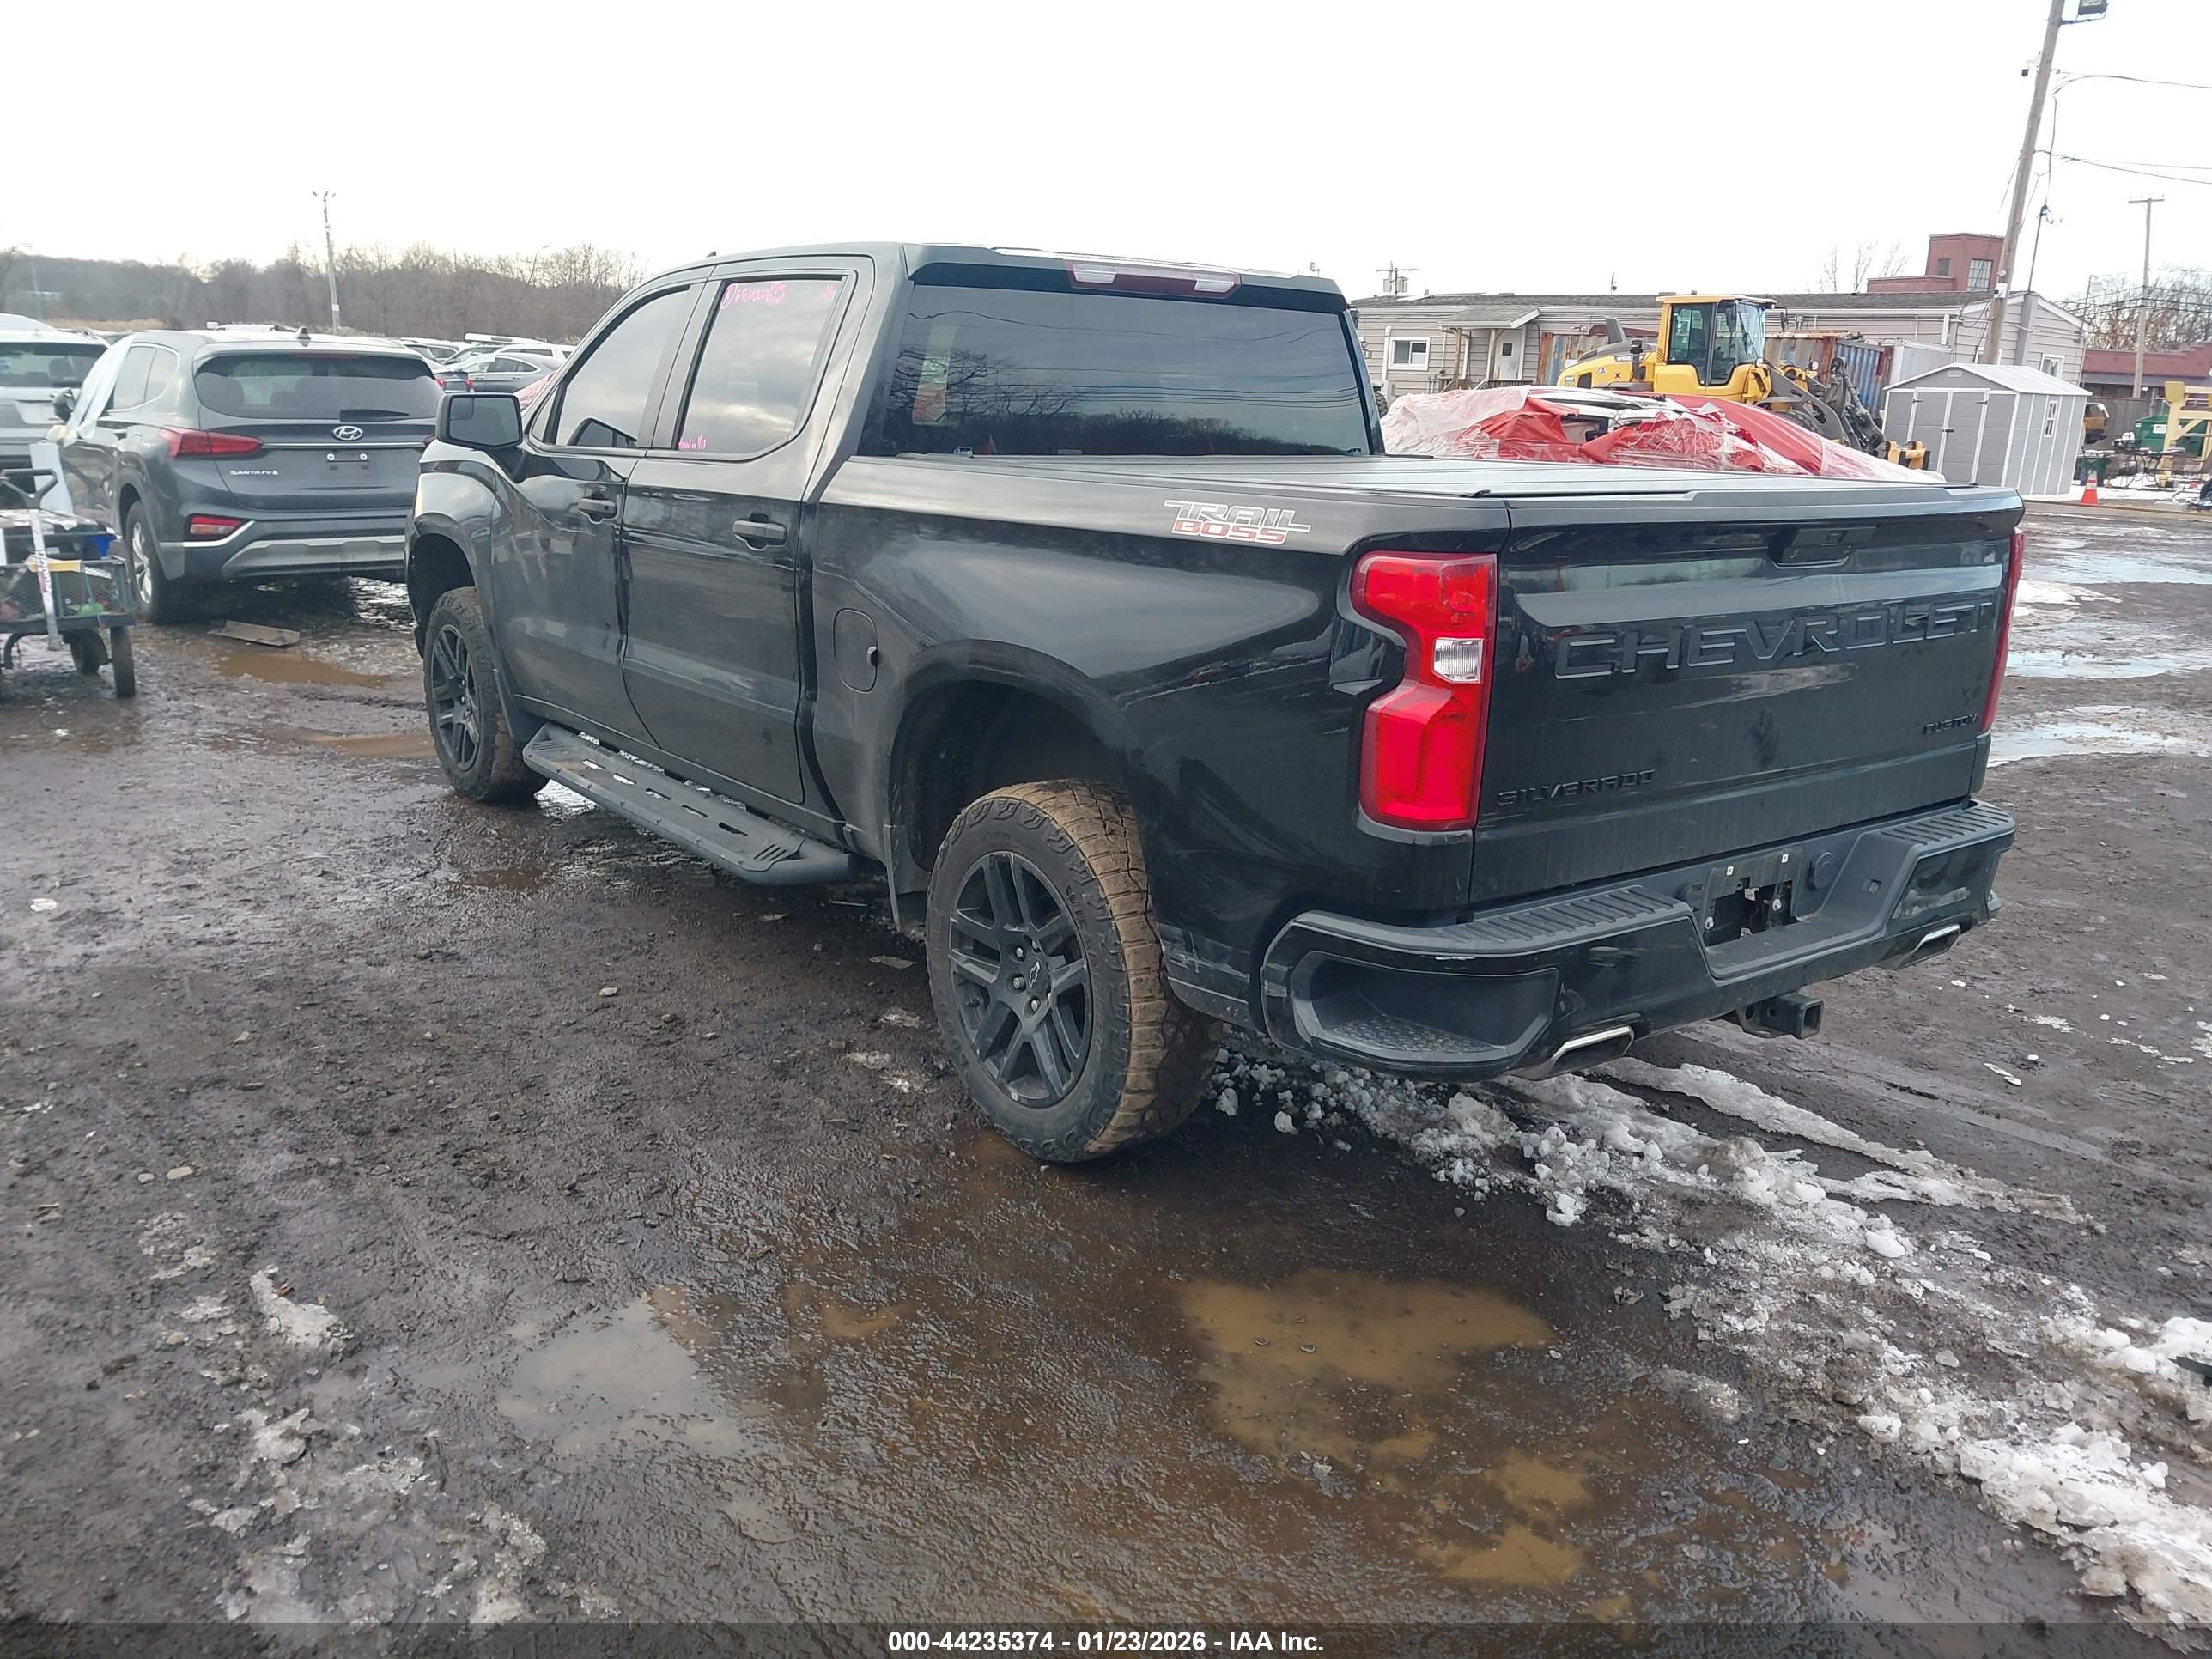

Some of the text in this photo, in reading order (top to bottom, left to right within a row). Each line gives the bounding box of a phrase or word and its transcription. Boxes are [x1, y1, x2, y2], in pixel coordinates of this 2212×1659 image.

[1164, 500, 1311, 533] TRAIL
[1171, 519, 1288, 545] BOSS
[1555, 600, 1994, 680] CHEVROLET
[1923, 713, 1979, 734] CUSTOM
[1497, 769, 1656, 805] SILVERADO
